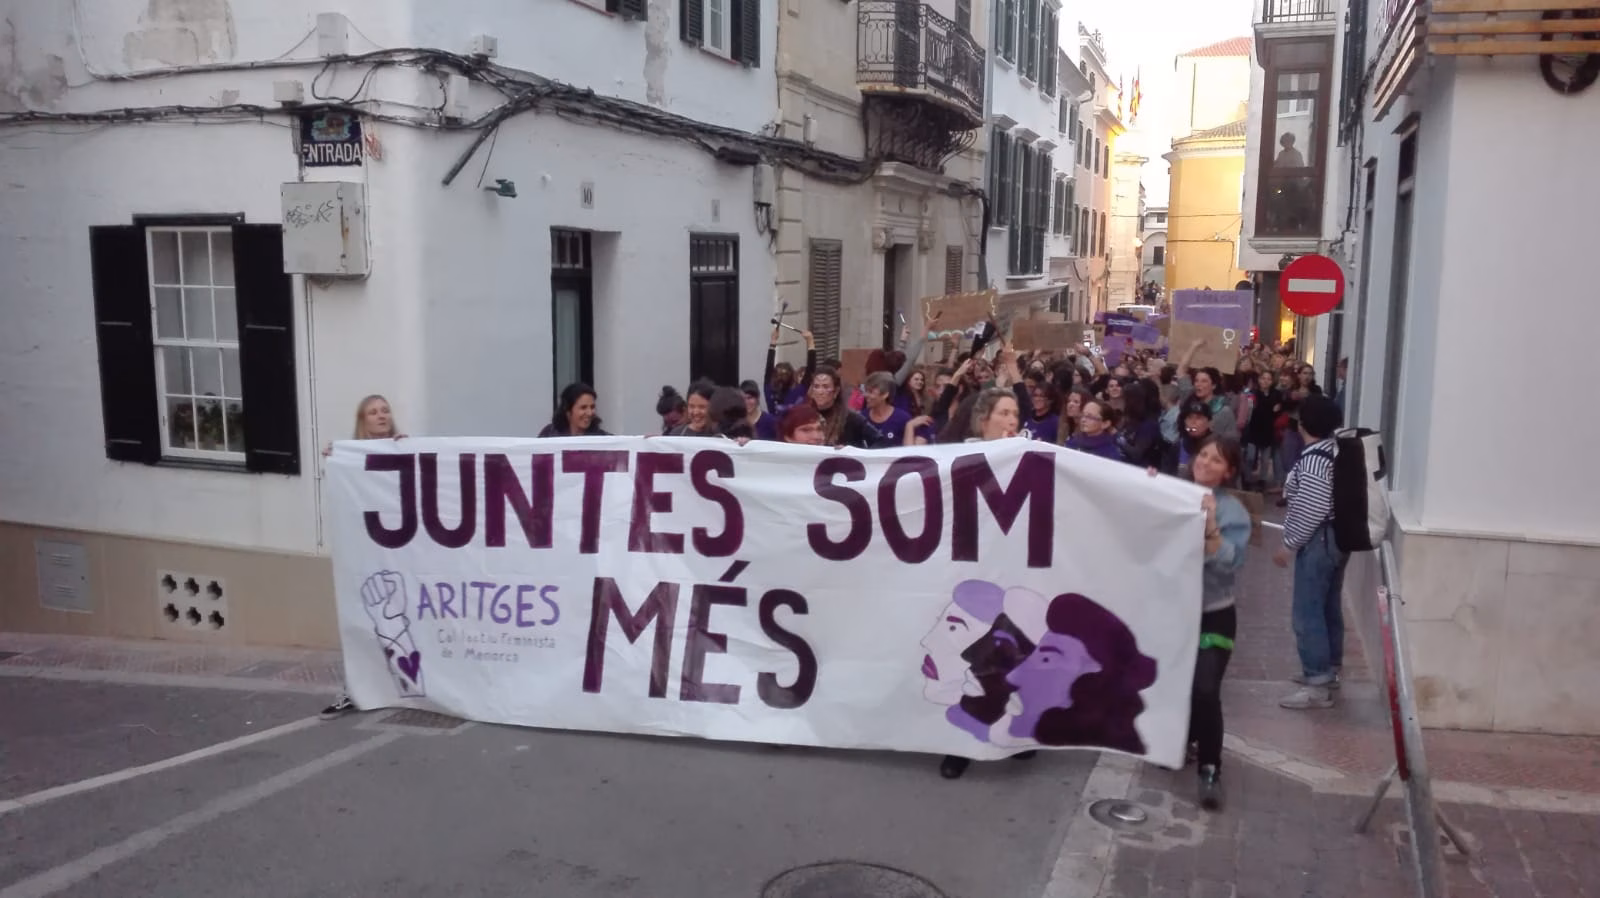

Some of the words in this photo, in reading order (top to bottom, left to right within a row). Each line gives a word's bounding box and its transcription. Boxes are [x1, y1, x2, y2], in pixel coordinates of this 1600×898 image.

[302, 142, 362, 163] ENTRADA
[363, 450, 744, 557] JUNTES
[807, 451, 1056, 568] SOM
[417, 581, 561, 627] ARITGES
[582, 560, 818, 709] MÉS
